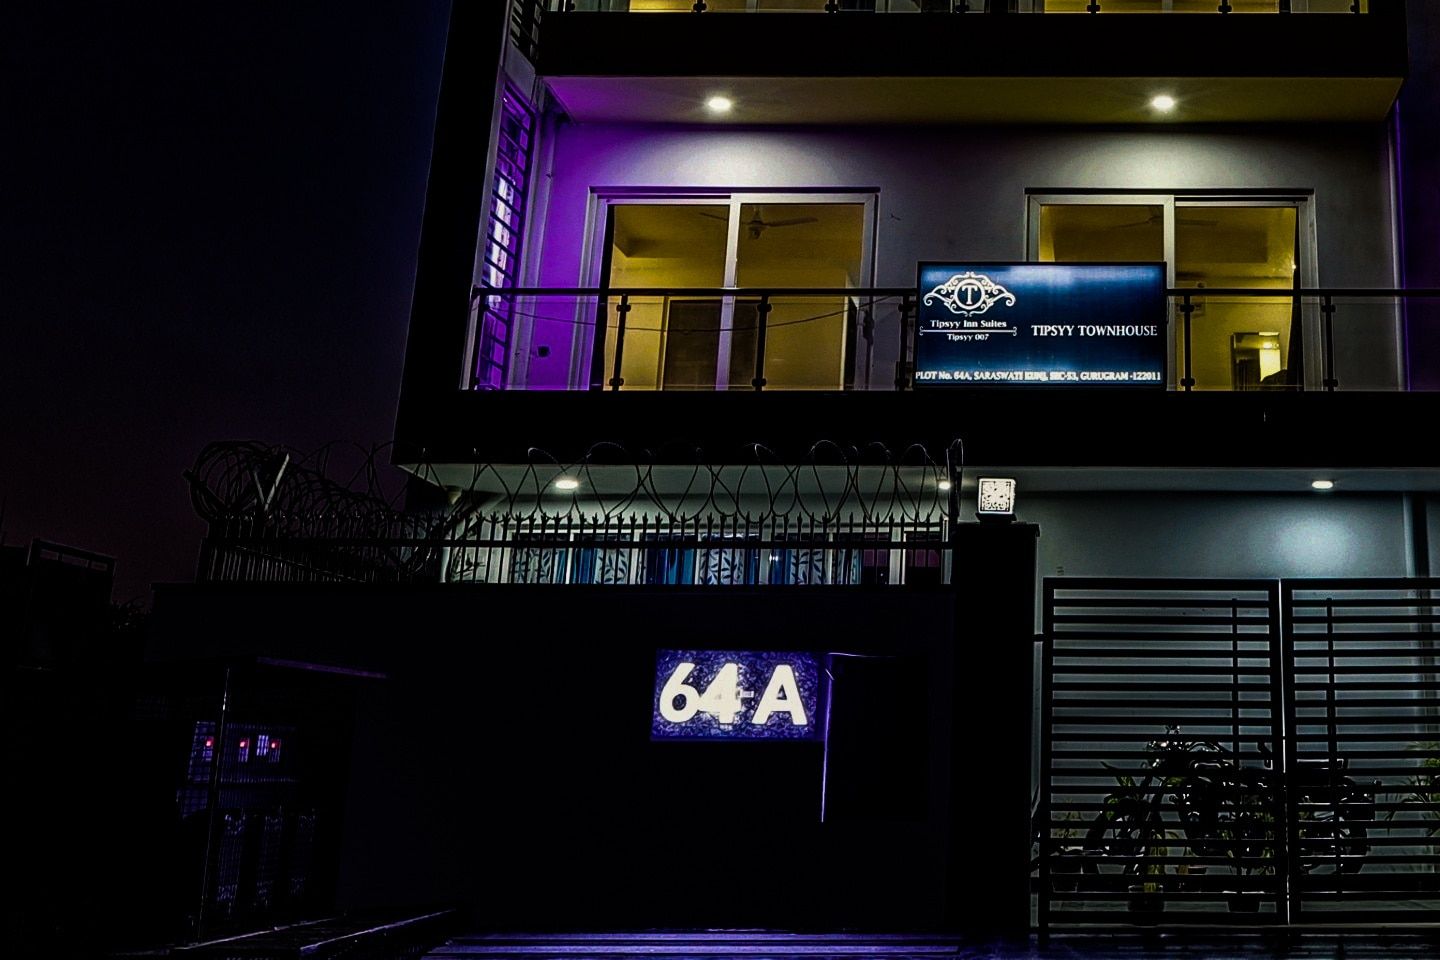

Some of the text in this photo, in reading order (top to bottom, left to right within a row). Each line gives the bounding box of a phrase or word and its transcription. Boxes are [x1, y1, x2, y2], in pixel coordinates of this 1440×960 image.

[961, 285, 978, 305] T
[930, 319, 1007, 329] Tipsyy Inn Suites
[1031, 325, 1158, 337] TIPSYY TOWNHOUSE
[947, 333, 990, 342] Tipsyy 007
[915, 370, 937, 380] PLOT
[938, 371, 952, 380] No.
[953, 371, 972, 381] 64A,
[973, 371, 1023, 381] SARASWATI
[1080, 371, 1129, 381] GURUGRAM
